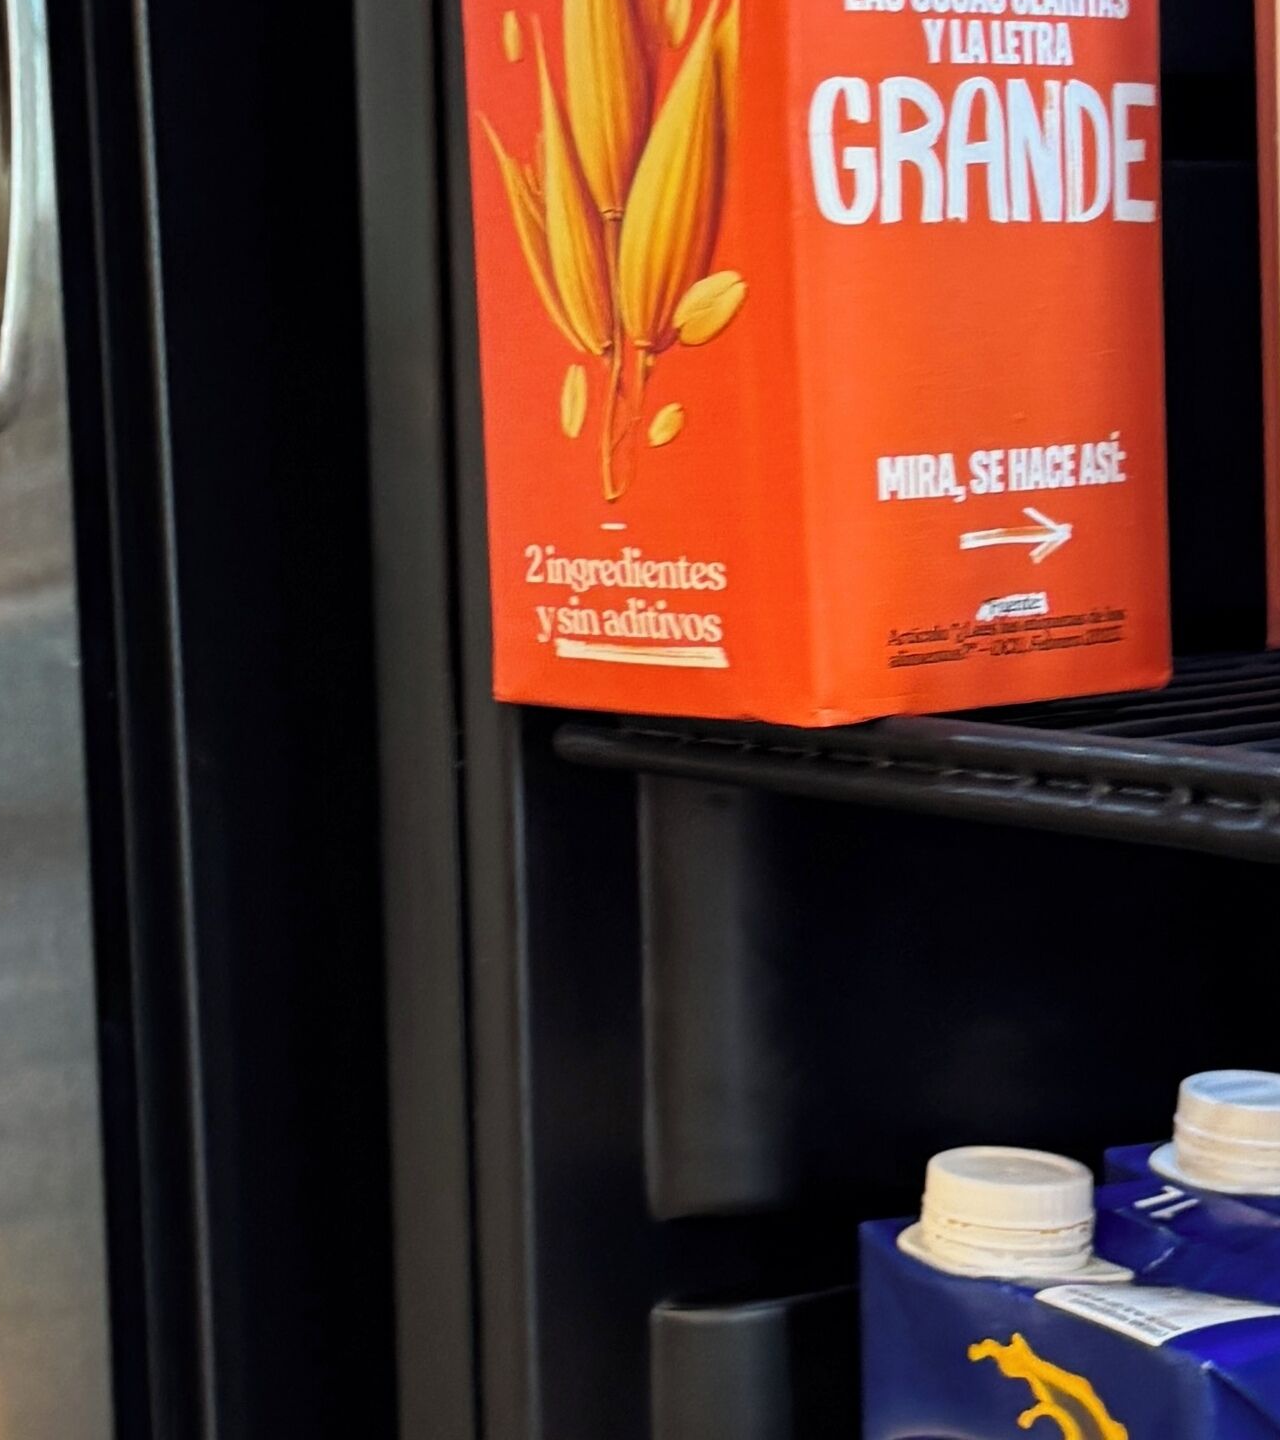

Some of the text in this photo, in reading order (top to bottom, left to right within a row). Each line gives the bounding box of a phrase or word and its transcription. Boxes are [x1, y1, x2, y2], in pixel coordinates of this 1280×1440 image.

[922, 18, 1074, 67] Y LA LETRA
[808, 76, 1157, 225] GRANDE
[877, 452, 967, 503] MIRA,
[969, 449, 1004, 494] SE
[1007, 444, 1076, 491] HACE
[524, 543, 728, 593] 2 ingredientes
[535, 595, 724, 643] y sin aditivos
